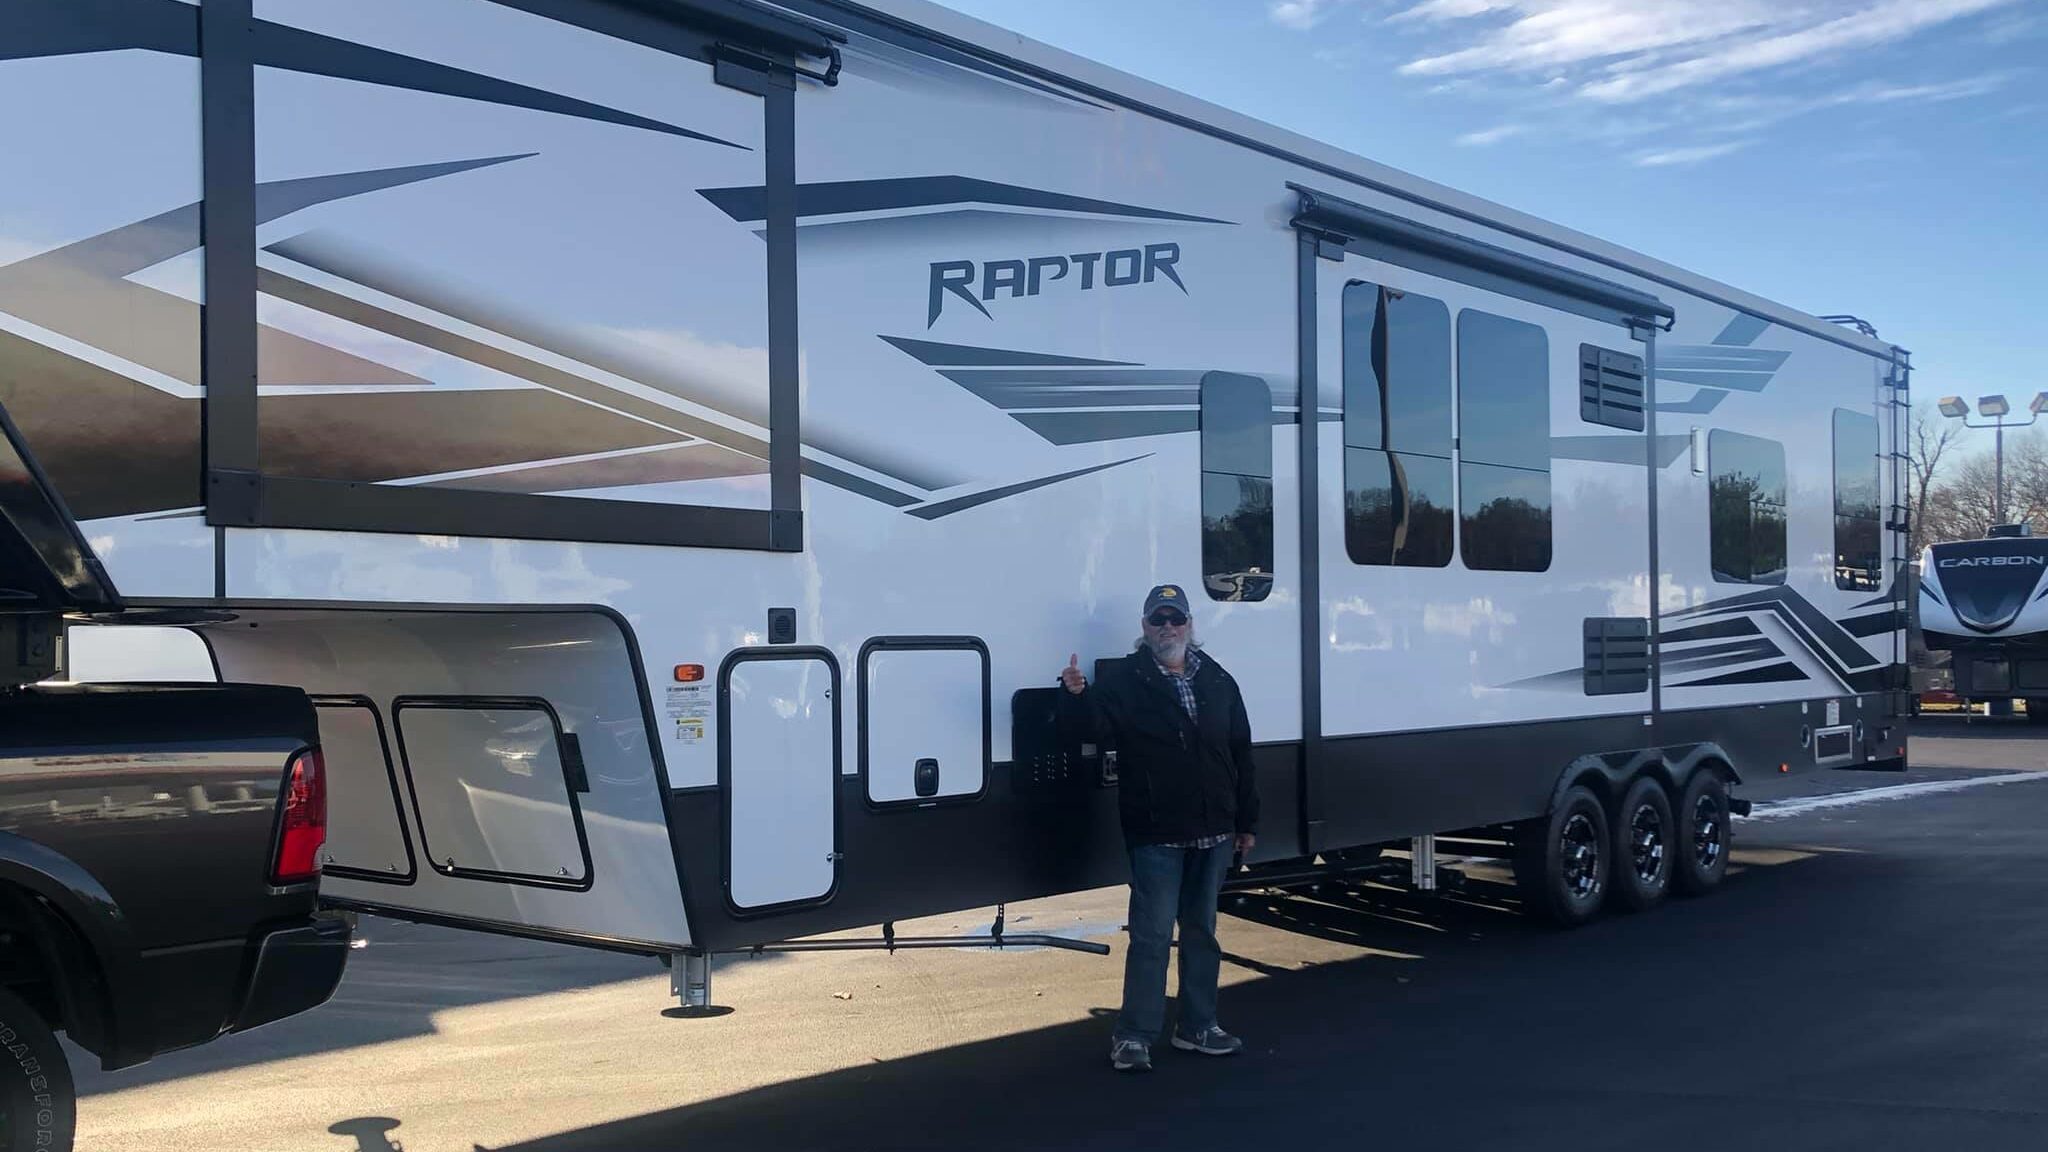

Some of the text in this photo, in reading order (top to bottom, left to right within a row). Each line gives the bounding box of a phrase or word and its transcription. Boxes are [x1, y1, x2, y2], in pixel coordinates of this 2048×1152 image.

[927, 243, 1190, 330] RAPTOR
[1939, 555, 2045, 568] CARBON
[0, 1019, 53, 1152] RANSFOR
